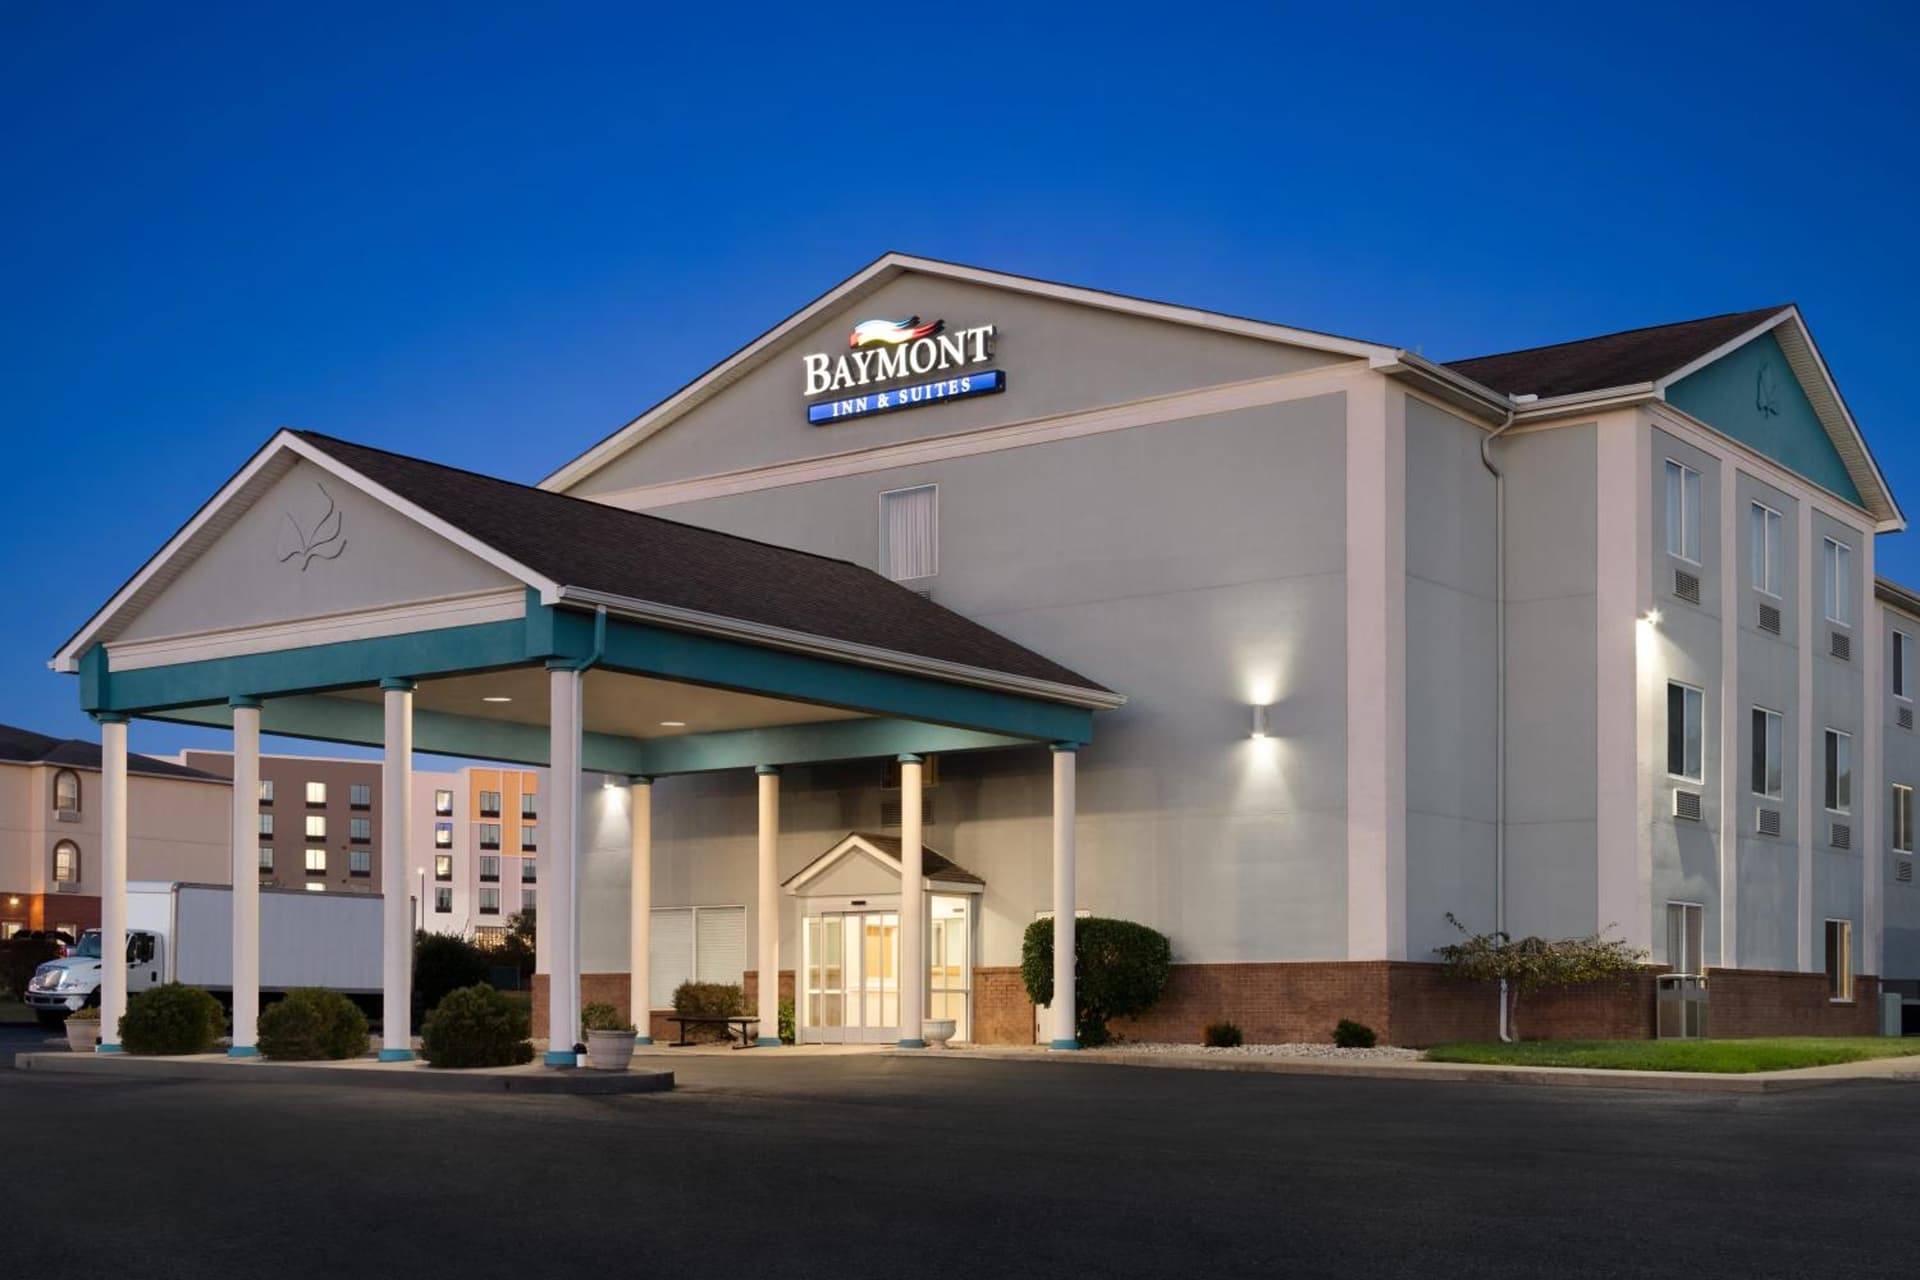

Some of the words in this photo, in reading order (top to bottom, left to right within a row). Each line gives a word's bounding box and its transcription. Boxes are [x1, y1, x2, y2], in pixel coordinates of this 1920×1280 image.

[803, 324, 994, 396] BAYMONT
[832, 397, 868, 417] INN
[877, 393, 890, 409] &
[899, 377, 971, 404] SUITES
